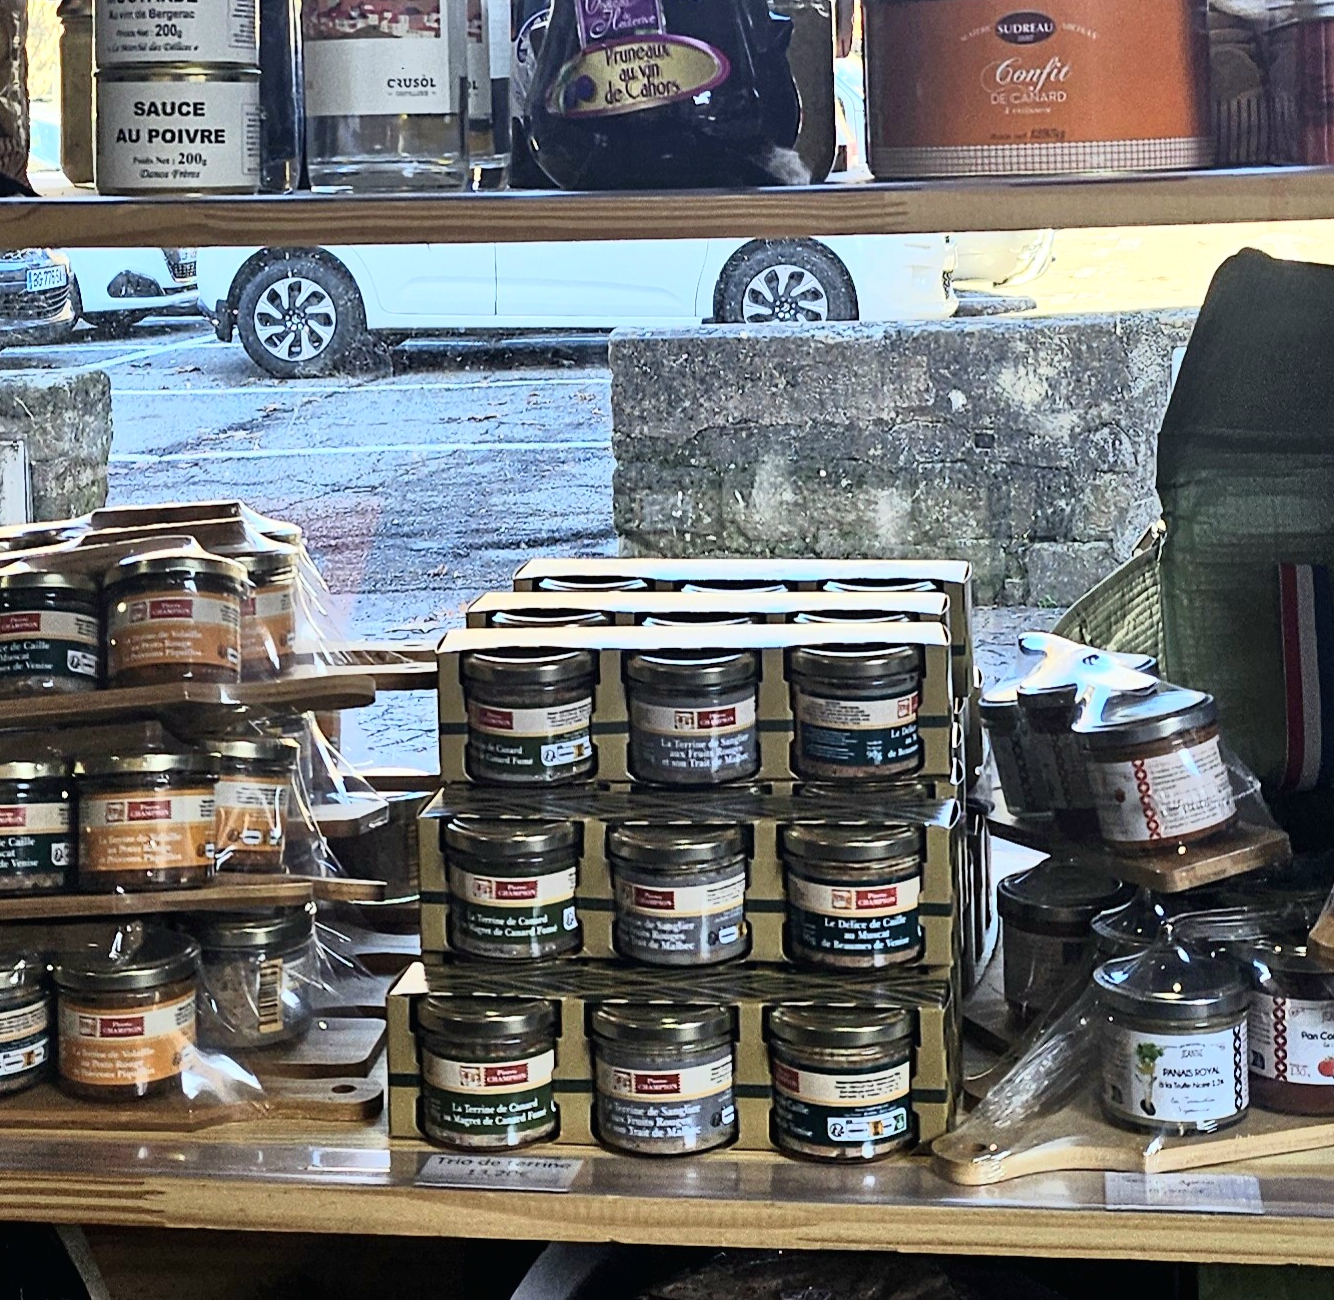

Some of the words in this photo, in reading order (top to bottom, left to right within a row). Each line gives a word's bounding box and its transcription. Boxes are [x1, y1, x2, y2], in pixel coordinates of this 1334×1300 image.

[998, 20, 1054, 34] SUDREAU
[605, 43, 670, 67] Pruneaux
[987, 56, 1071, 92] Confit
[605, 86, 624, 105] de
[624, 74, 681, 100] Cahors
[990, 93, 1007, 105] DE
[1011, 91, 1067, 104] CANARD
[134, 102, 205, 117] SAUCE
[116, 130, 140, 144] AU
[147, 129, 226, 144] POIVRE
[178, 153, 207, 167] 200g
[23, 640, 50, 650] Caille
[8, 836, 36, 847] Caille
[11, 858, 38, 868] Venise
[518, 914, 548, 926] Canard
[656, 919, 695, 932] Sanglier
[661, 938, 695, 950] Malbec
[1301, 1031, 1318, 1041] Pan
[1195, 1066, 1220, 1077] ROYAL
[464, 1102, 495, 1114] Terrine
[509, 1097, 539, 1113] Canard
[495, 1114, 526, 1127] Canard
[437, 1156, 473, 1167] Trio
